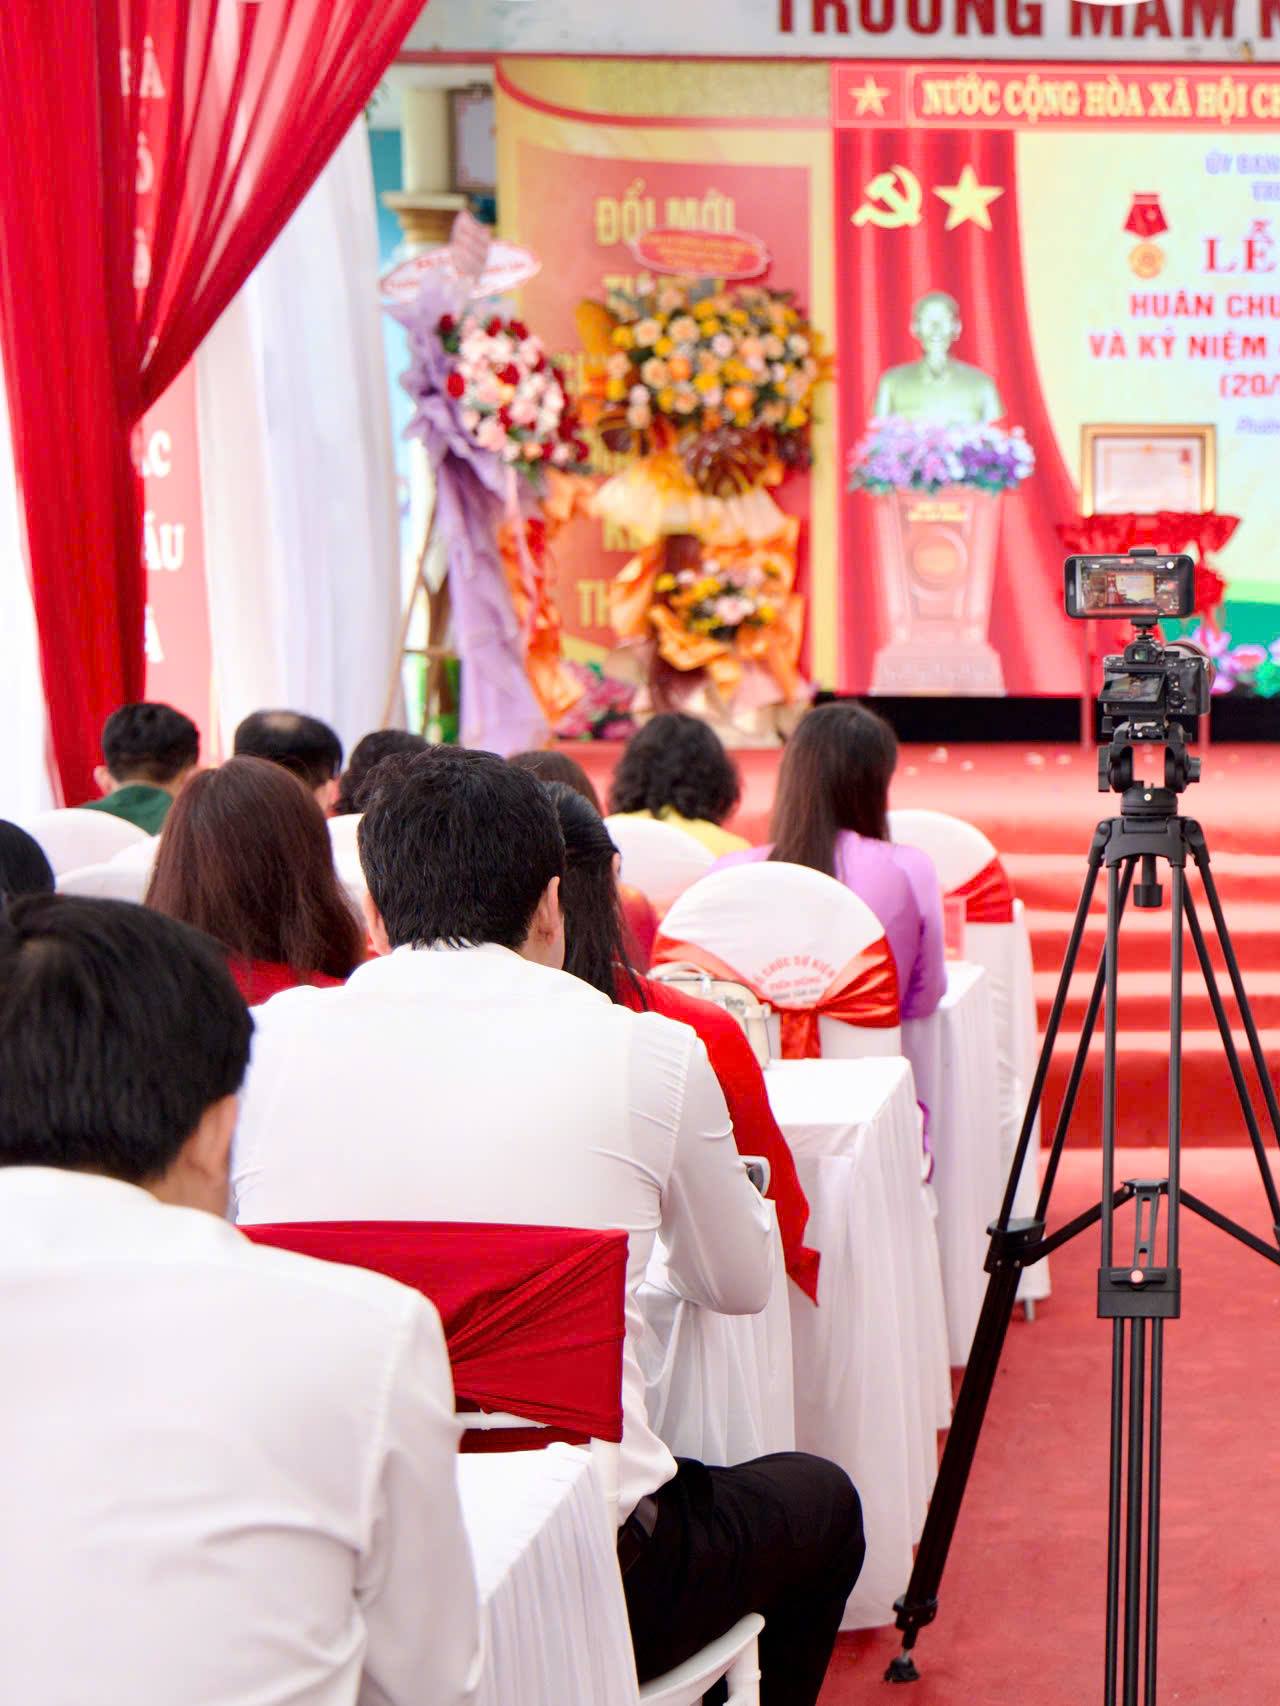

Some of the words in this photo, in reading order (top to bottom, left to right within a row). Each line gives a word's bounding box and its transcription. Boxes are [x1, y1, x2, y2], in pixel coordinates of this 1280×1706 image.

[923, 72, 999, 116] NƯỚC
[1005, 73, 1080, 124] CỘNG
[1084, 74, 1144, 117] HÒA
[1148, 76, 1192, 117] XÃ
[1196, 76, 1248, 125] HỘI
[1202, 218, 1276, 274] LỄ
[1130, 290, 1214, 318] HUÂN
[1089, 330, 1128, 358] VÀ
[1188, 331, 1267, 367] NIỆM
